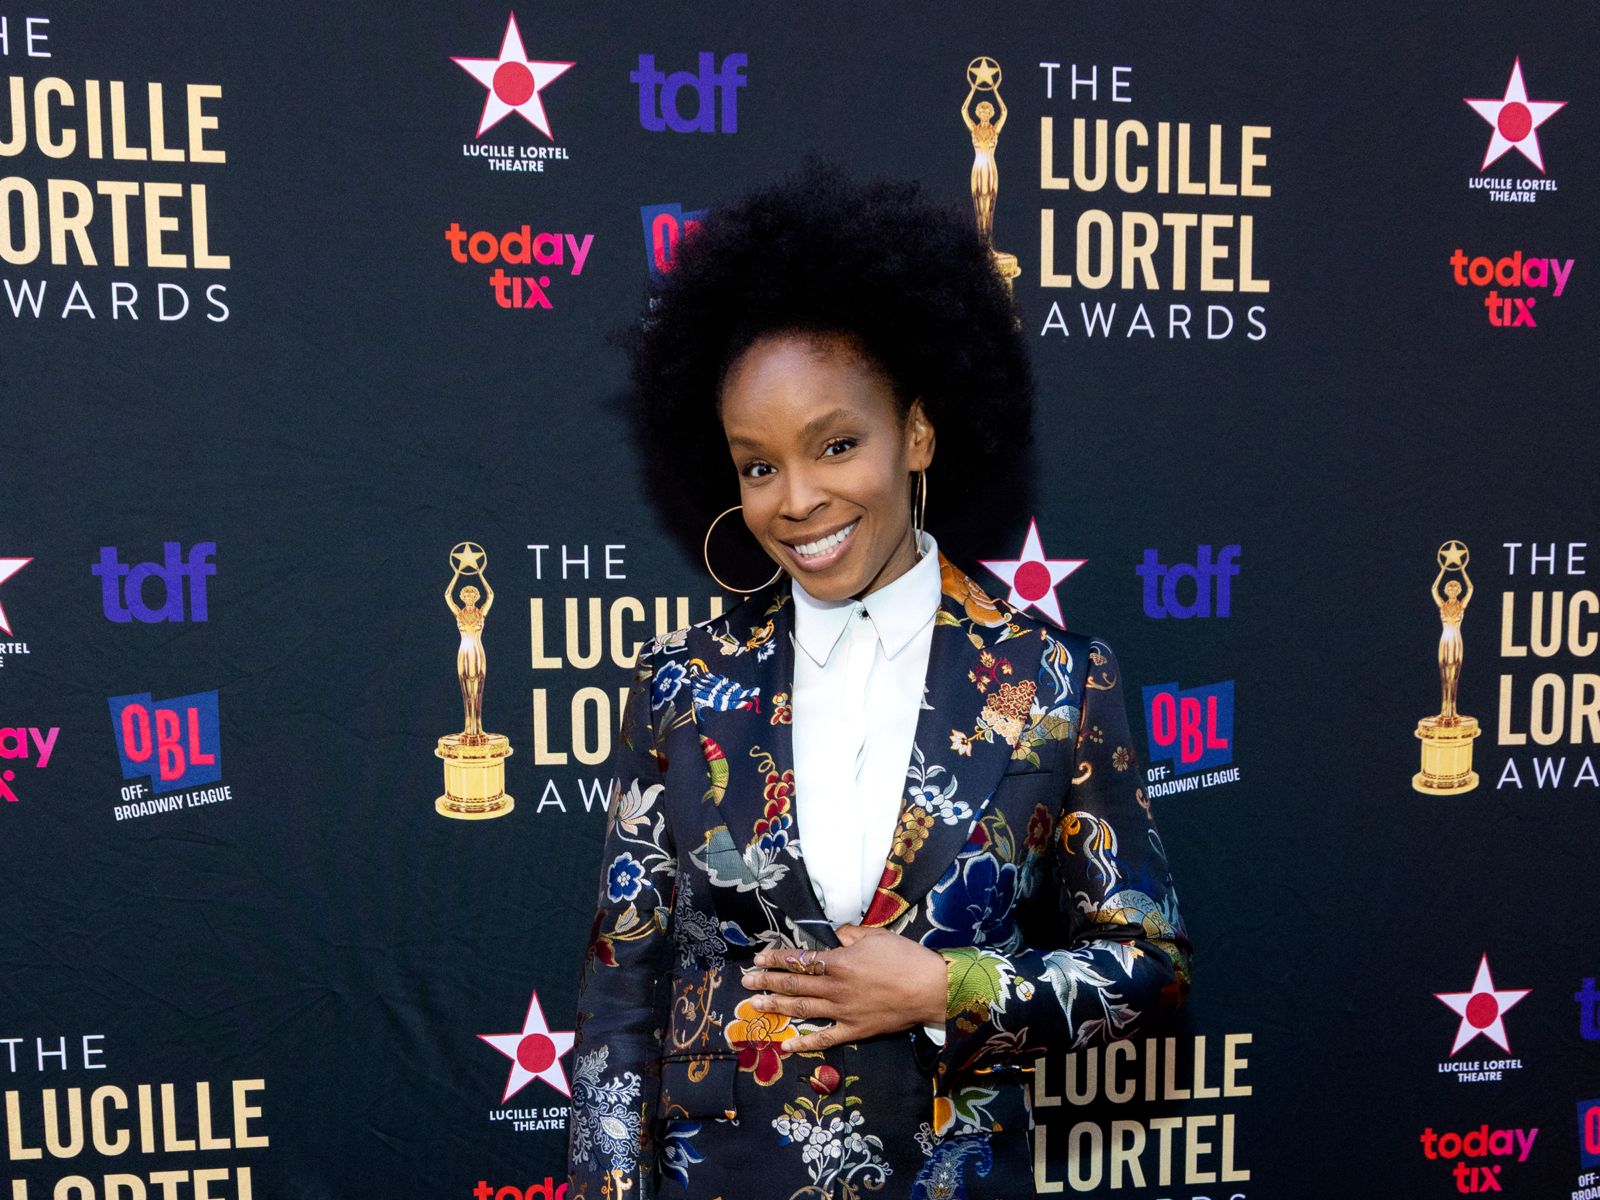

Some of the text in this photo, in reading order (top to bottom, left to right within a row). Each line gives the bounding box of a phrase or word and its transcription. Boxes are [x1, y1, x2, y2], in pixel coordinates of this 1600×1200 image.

[630, 52, 747, 133] tdf
[1040, 63, 1131, 102] THE
[0, 77, 225, 163] UCILLE
[463, 144, 569, 159] LUCILLE LORTEL
[488, 159, 544, 172] THEATRE
[1041, 117, 1271, 197] LUCILLE
[1469, 178, 1557, 191] LUCILLE LORTEL
[1489, 191, 1536, 203] THEATRE
[0, 177, 230, 269] ORTEL
[445, 223, 594, 275] today
[1041, 209, 1269, 292] LORTEL
[490, 269, 552, 308] tix
[1450, 249, 1575, 297] today
[4, 279, 229, 322] WARDS
[1485, 291, 1536, 327] tix
[1041, 302, 1266, 340] AWARDS
[527, 545, 626, 579] THE
[1503, 543, 1586, 575] THE
[92, 542, 216, 623] tdf
[1136, 544, 1241, 618] tdf
[0, 643, 30, 654] RTEL
[1498, 673, 1600, 745] LOR
[121, 704, 214, 780] OBL
[1152, 693, 1227, 763] OBL
[1147, 766, 1171, 782] OFF-
[1148, 768, 1240, 798] ROADWAY LEAGUE
[1497, 757, 1599, 789] AWA
[114, 786, 232, 821] BROADWAY LEAGUE
[120, 784, 149, 801] OFF-
[0, 1035, 106, 1072] THE
[1034, 1033, 1253, 1107] LUCILLE
[1438, 1060, 1522, 1073] LUCILLE LORTEL
[1458, 1071, 1502, 1082] THEATRE
[6, 1079, 269, 1160] LUCILLE
[490, 1106, 571, 1120] LUCILLE LOR
[513, 1119, 565, 1131] THEATRE
[1034, 1114, 1251, 1194] LORTEL
[1420, 1125, 1539, 1162] today
[1453, 1162, 1501, 1193] tix
